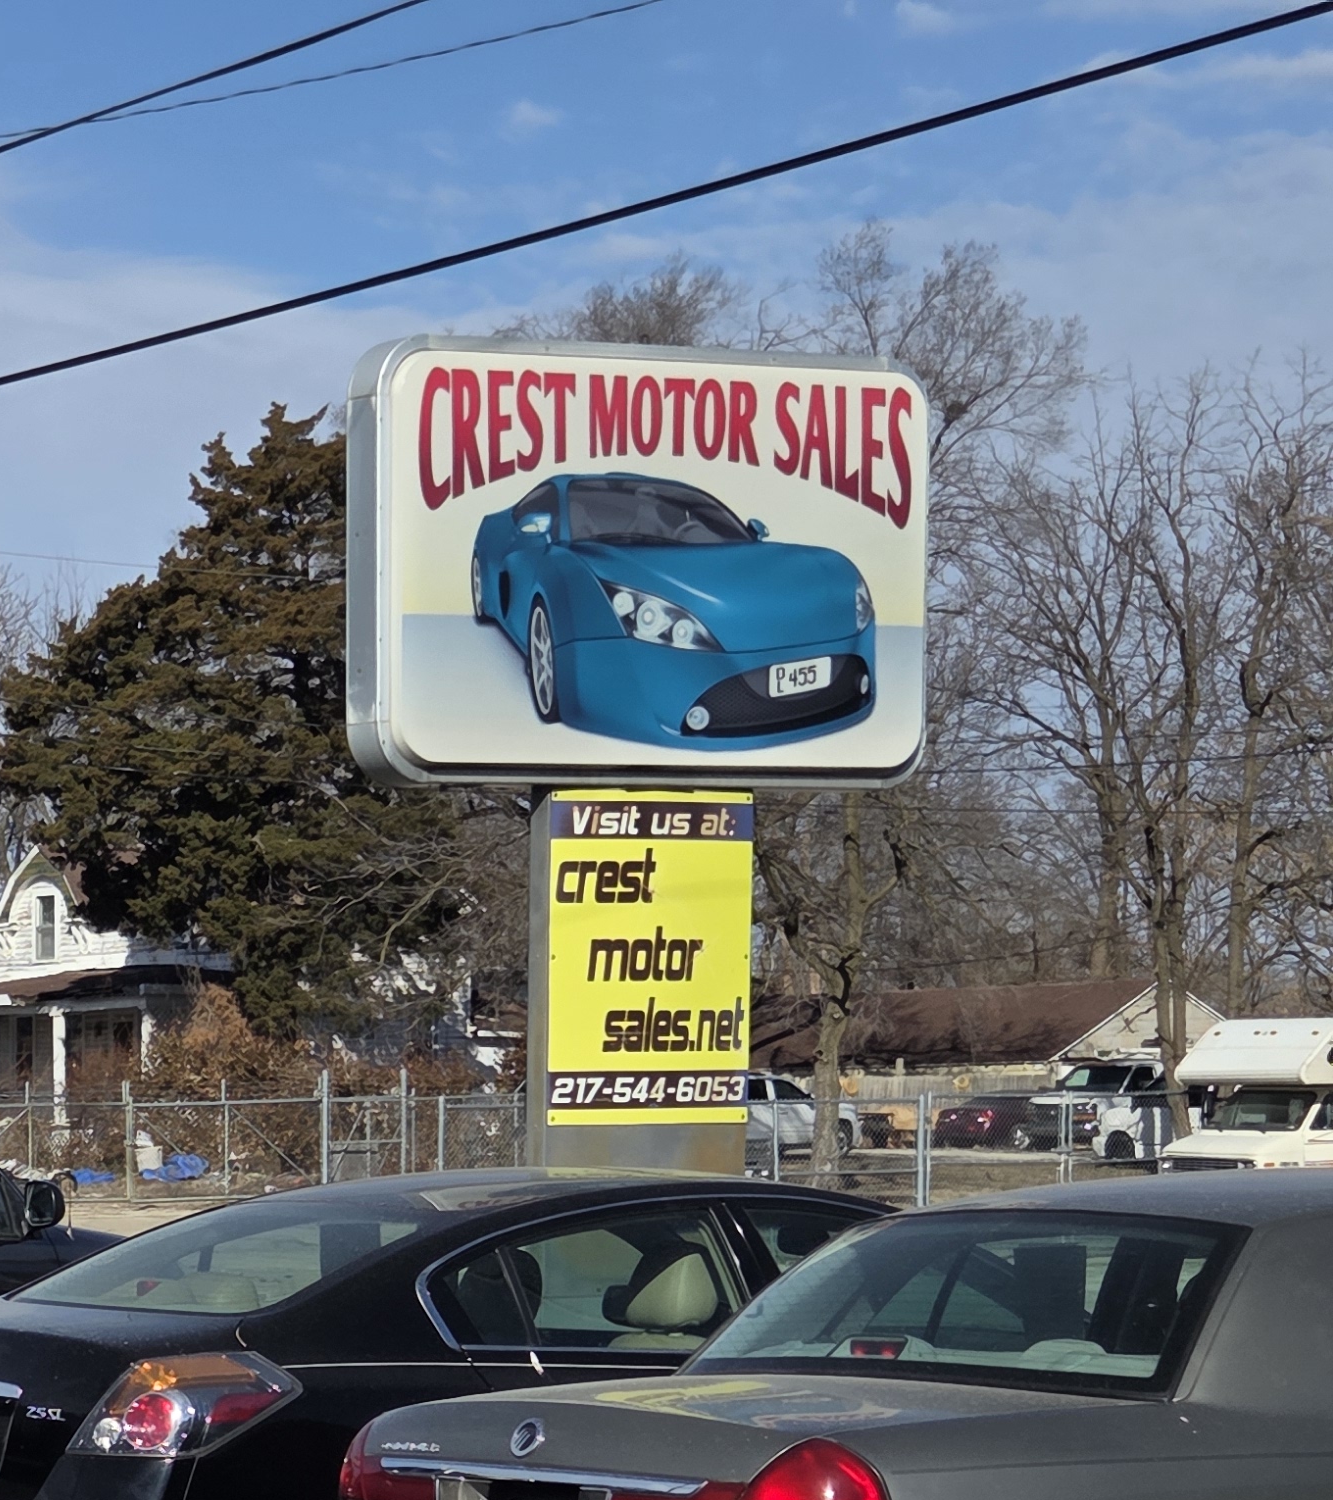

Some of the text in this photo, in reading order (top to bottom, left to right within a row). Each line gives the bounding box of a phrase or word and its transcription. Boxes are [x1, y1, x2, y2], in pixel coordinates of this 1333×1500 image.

[419, 366, 912, 530] CREST MOTOR SALES
[789, 665, 817, 688] 455
[572, 806, 737, 836] Visit us at:
[555, 847, 657, 904] crest
[587, 925, 704, 982] motor
[602, 996, 745, 1053] sales.net
[550, 1075, 746, 1105] 217-544-6053
